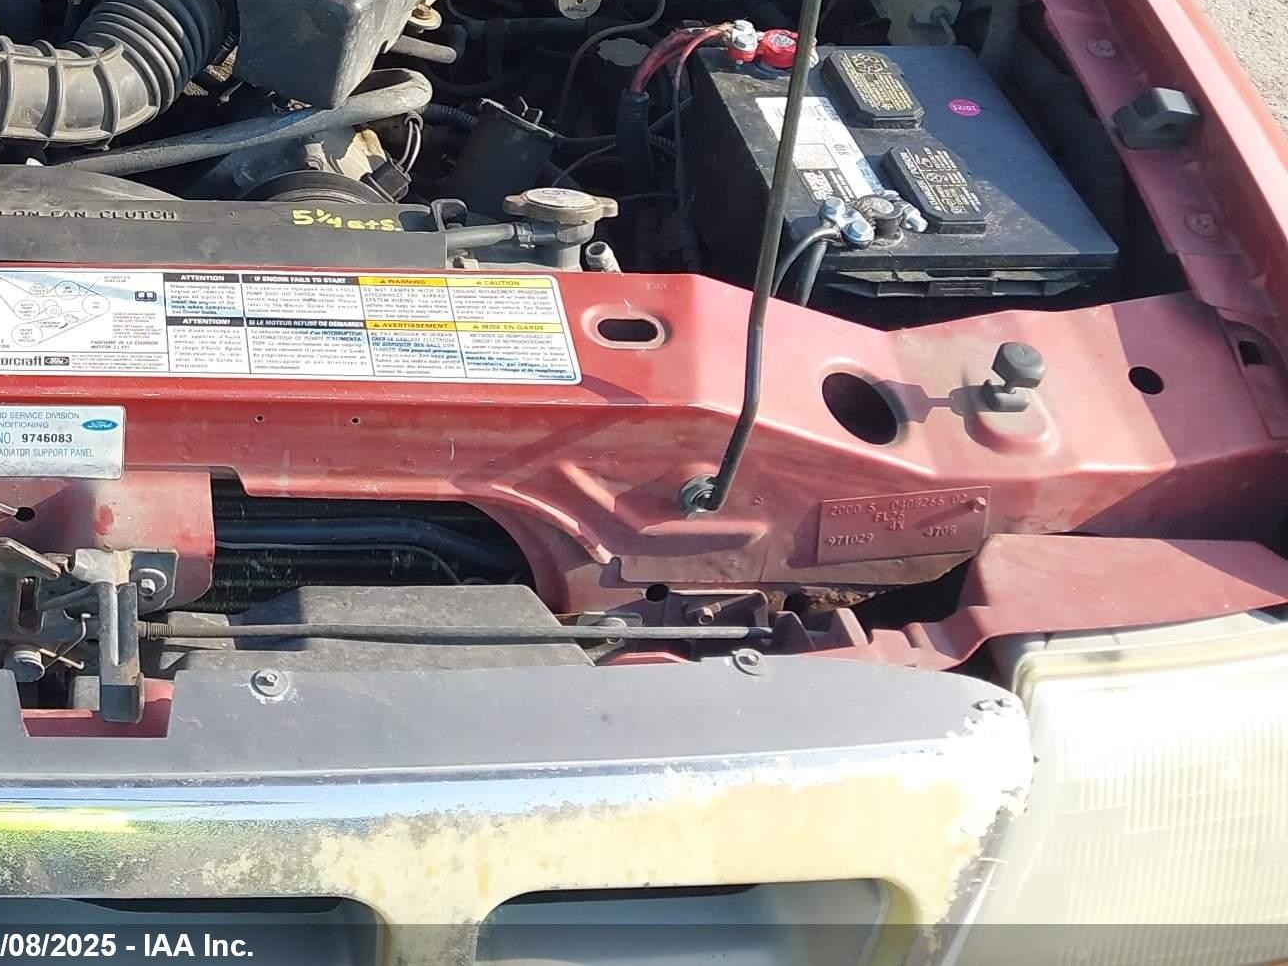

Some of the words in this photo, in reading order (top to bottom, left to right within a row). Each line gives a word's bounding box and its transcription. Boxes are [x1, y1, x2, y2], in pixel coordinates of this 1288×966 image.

[99, 210, 176, 220] CLUTCH
[86, 420, 113, 429] Ford
[21, 433, 73, 443] 9746083
[33, 449, 68, 457] SUPPORT
[70, 449, 94, 457] PANEL
[831, 505, 862, 516] 2000
